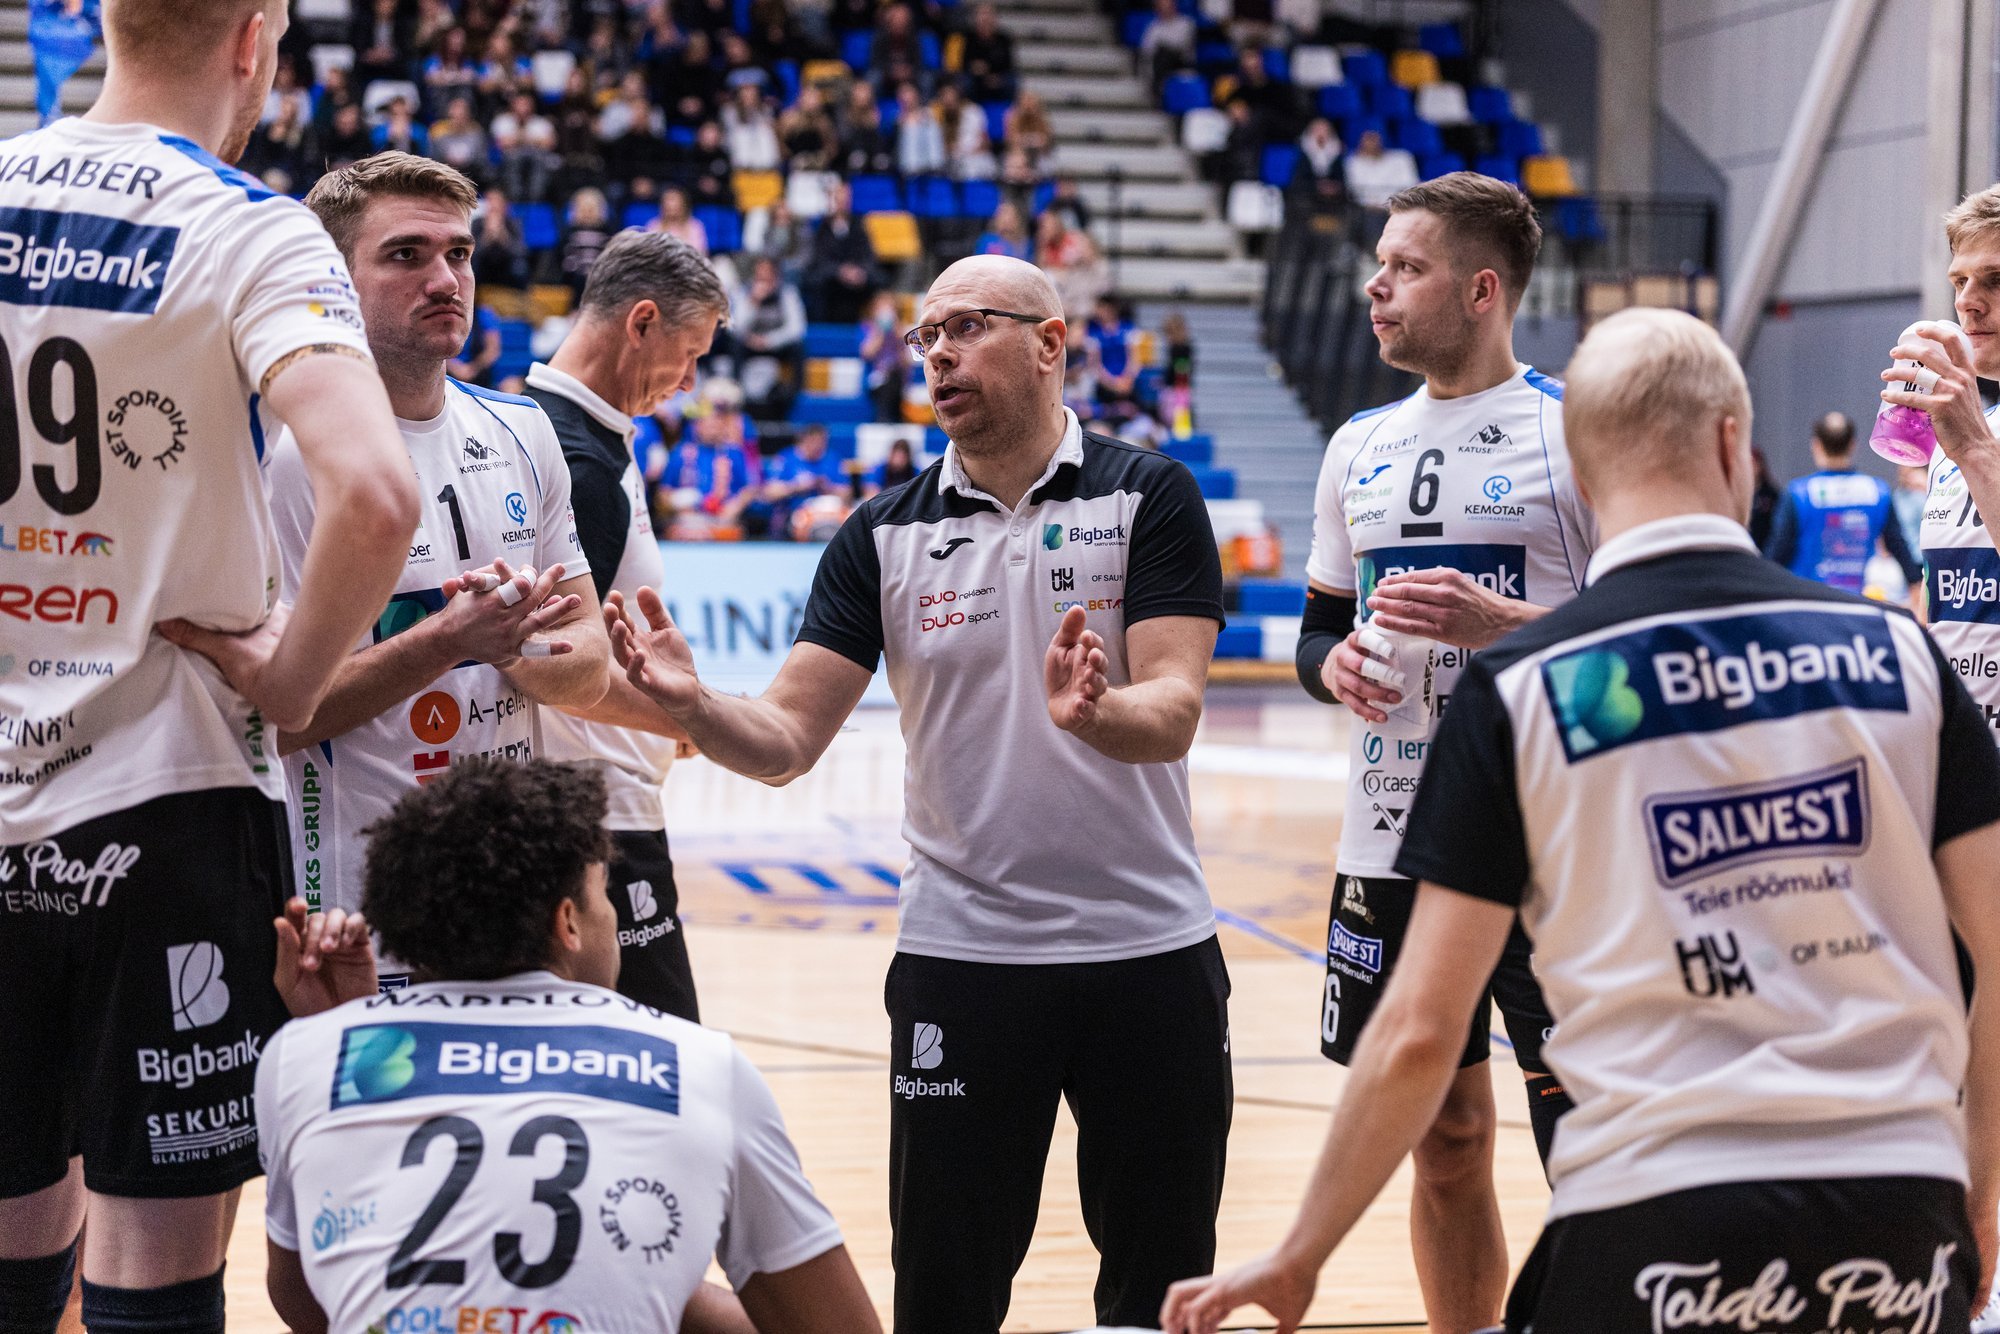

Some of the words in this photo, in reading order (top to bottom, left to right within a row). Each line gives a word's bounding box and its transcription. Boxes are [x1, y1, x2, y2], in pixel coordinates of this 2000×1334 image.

[0, 231, 162, 291] Bigbank
[0, 335, 101, 516] 9
[107, 389, 188, 471] SPORDIHALL
[1372, 434, 1418, 454] SEKURIT
[106, 429, 142, 470] NET
[1458, 446, 1520, 454] KATUSEFIRMA
[1409, 448, 1445, 516] 6
[437, 483, 471, 561] 1
[1353, 508, 1388, 524] weber
[1465, 505, 1525, 517] KEMOTAR
[1068, 525, 1126, 546] Bigbank
[919, 591, 957, 607] DUO
[958, 586, 996, 601] reklaam
[1938, 568, 2000, 609] Bigba
[921, 612, 965, 632] DUO
[968, 610, 1000, 625] sport
[28, 659, 52, 677] OF
[55, 660, 114, 677] SAUNA
[1653, 633, 1895, 709] Bigbank
[302, 761, 322, 852] GRUPP
[1664, 784, 1853, 867] SALVEST
[23, 840, 141, 907] Proff
[0, 890, 79, 916] ERING
[618, 916, 676, 947] Bigbank
[1332, 927, 1378, 966] SALVEST
[1322, 973, 1342, 1044] 6
[138, 1030, 261, 1089] Bigbank
[437, 1041, 670, 1091] Bigbank
[894, 1075, 966, 1100] Bigbank
[146, 1094, 257, 1137] SEKURI
[151, 1149, 211, 1165] GLAZING
[385, 1114, 591, 1291] 23
[605, 1176, 683, 1265] SPORDIHALL
[600, 1204, 630, 1252] NET
[1633, 1257, 1808, 1334] Toidu
[368, 1305, 528, 1334] OOLBET
